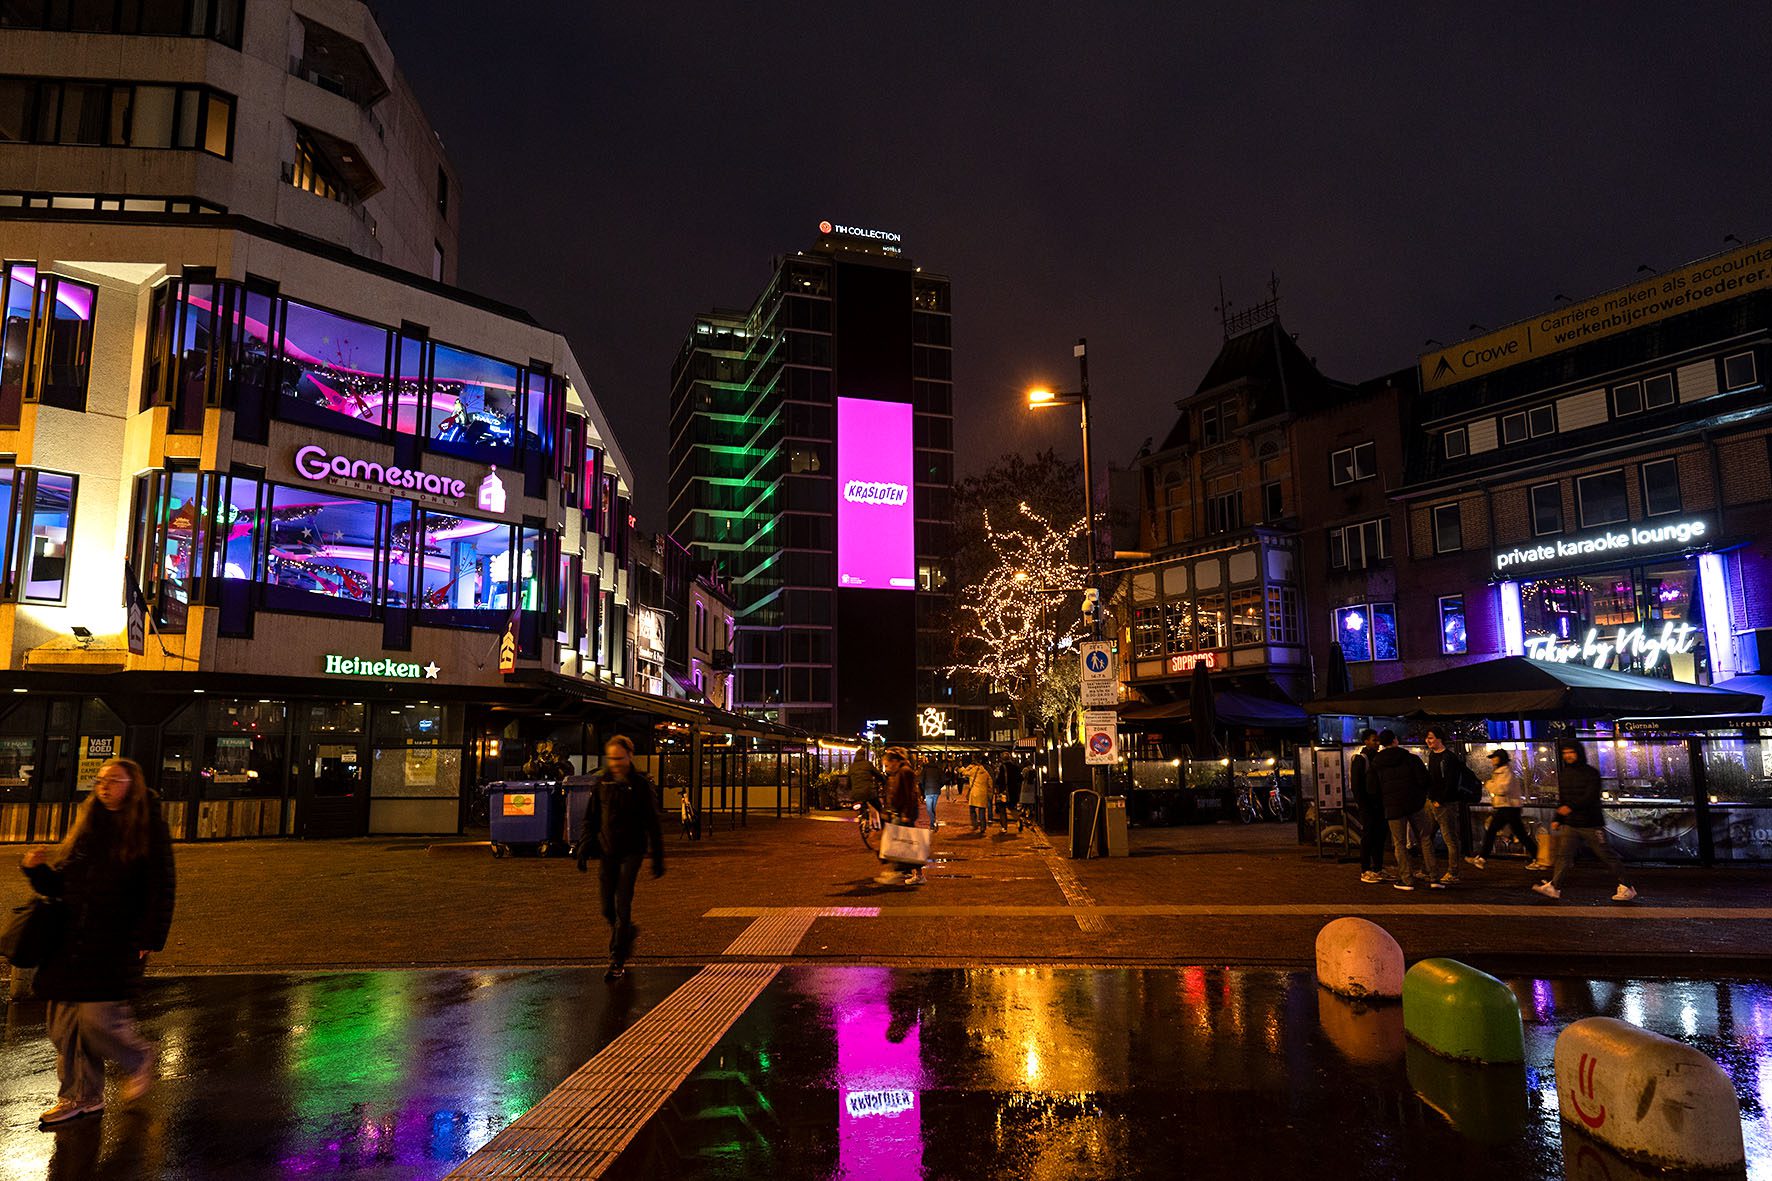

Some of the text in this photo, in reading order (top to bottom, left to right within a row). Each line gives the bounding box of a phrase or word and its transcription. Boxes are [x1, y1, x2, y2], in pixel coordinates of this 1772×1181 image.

[848, 227, 901, 241] COLLECTION
[1540, 307, 1600, 333] Carrière
[1604, 285, 1657, 312] maken
[1662, 274, 1686, 294] als
[1555, 267, 1772, 344] werkenbijcrowefoederer.
[1462, 340, 1519, 368] Crowe
[329, 477, 459, 506] WINNERS ONLY
[848, 485, 904, 501] KRASLOTEN
[1497, 520, 1705, 570] private karaoke lounge
[1523, 634, 1581, 664] Tokyo
[1582, 628, 1614, 669] by
[1615, 622, 1697, 670] Night
[325, 655, 420, 678] Heineken
[89, 745, 112, 753] GOED
[90, 738, 112, 746] VAST
